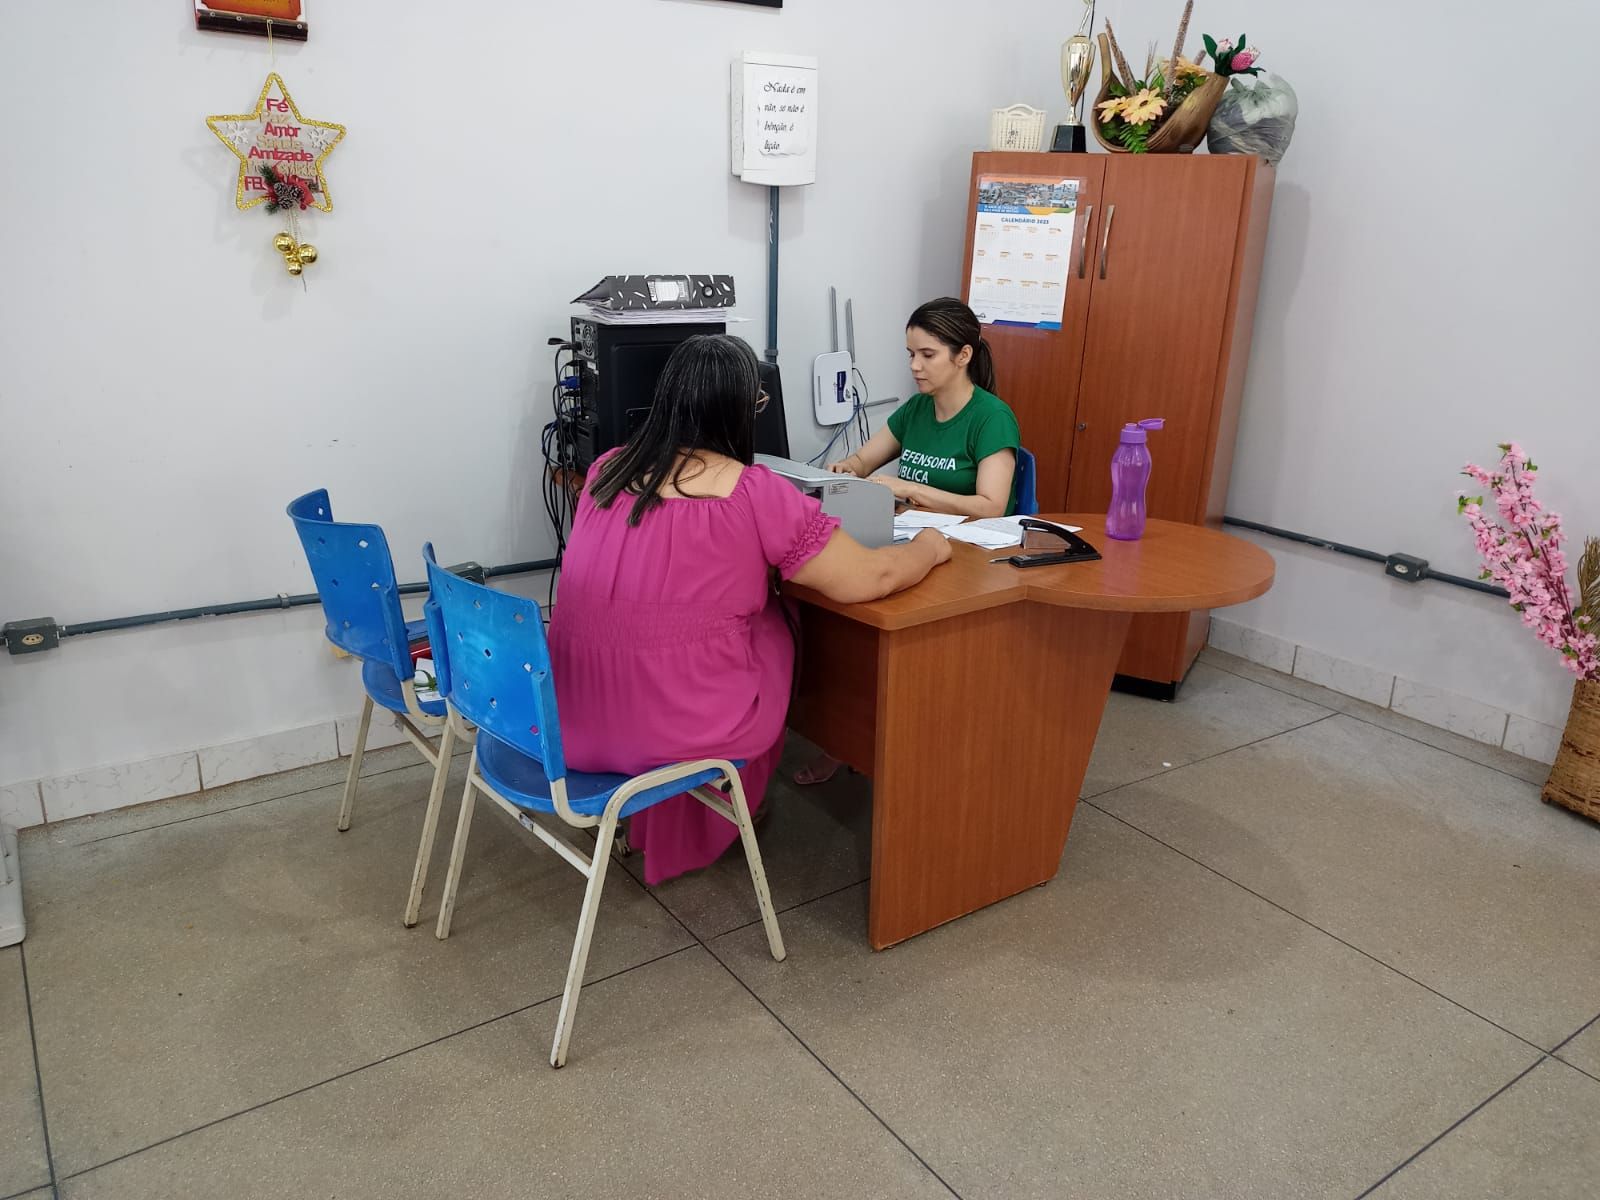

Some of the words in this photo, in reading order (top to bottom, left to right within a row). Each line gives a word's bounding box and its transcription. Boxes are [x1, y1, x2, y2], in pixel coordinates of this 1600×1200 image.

[266, 97, 288, 112] Fé
[248, 145, 314, 162] Amizade
[901, 449, 956, 471] EFENSORIA
